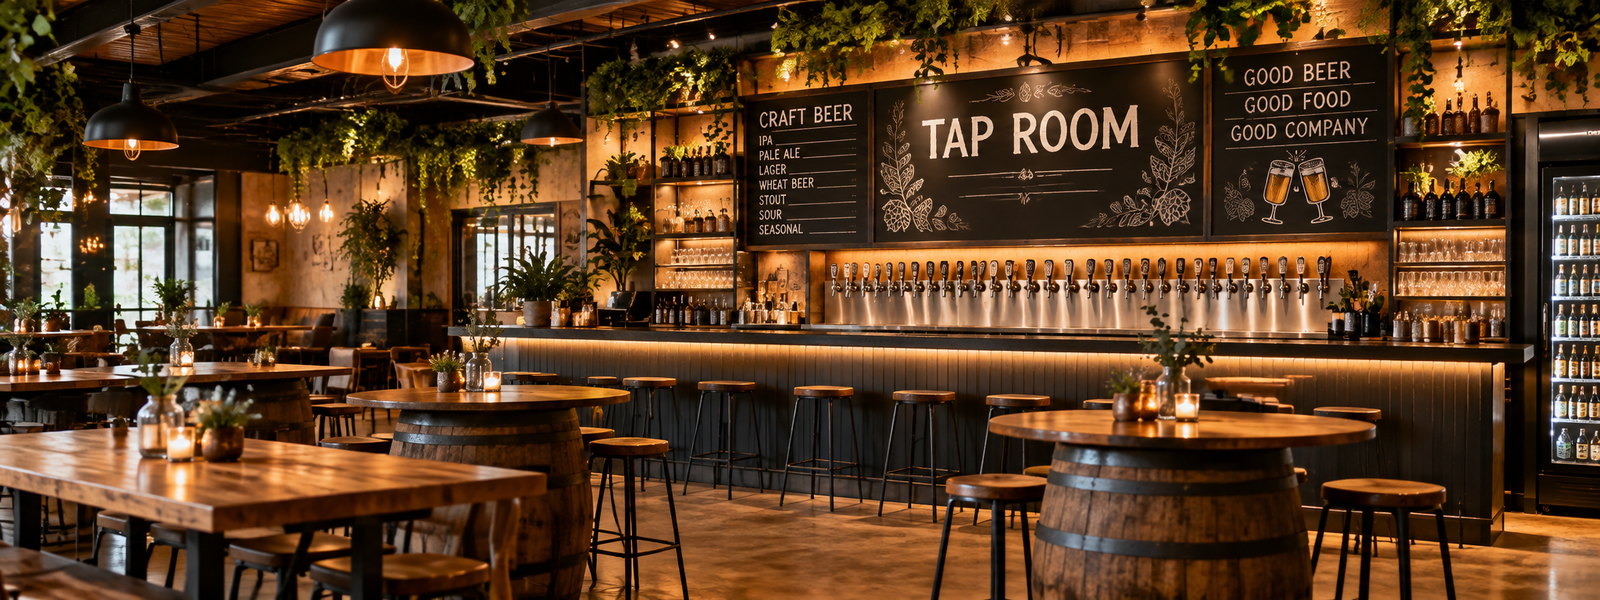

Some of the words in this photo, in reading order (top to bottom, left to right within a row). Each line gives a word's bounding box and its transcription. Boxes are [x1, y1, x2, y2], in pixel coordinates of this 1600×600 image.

[1244, 65, 1294, 87] GOOD
[1303, 60, 1351, 82] BEER
[1244, 94, 1293, 114] GOOD
[1303, 89, 1351, 110] FOOD
[759, 108, 807, 128] CRAFT
[814, 103, 853, 124] BEER
[921, 115, 994, 159] TAP
[1012, 104, 1140, 154] ROOM
[1230, 123, 1277, 142] GOOD
[1285, 117, 1369, 139] COMPANY
[758, 135, 773, 147] IPA
[759, 149, 780, 161] PALE
[783, 147, 800, 159] ALE
[759, 163, 787, 176] LAGER
[759, 178, 788, 191] WHEAT
[791, 177, 815, 189] BEER
[759, 193, 787, 206] STOUT
[759, 208, 782, 221] SOUR
[759, 223, 804, 236] SEASONAL
